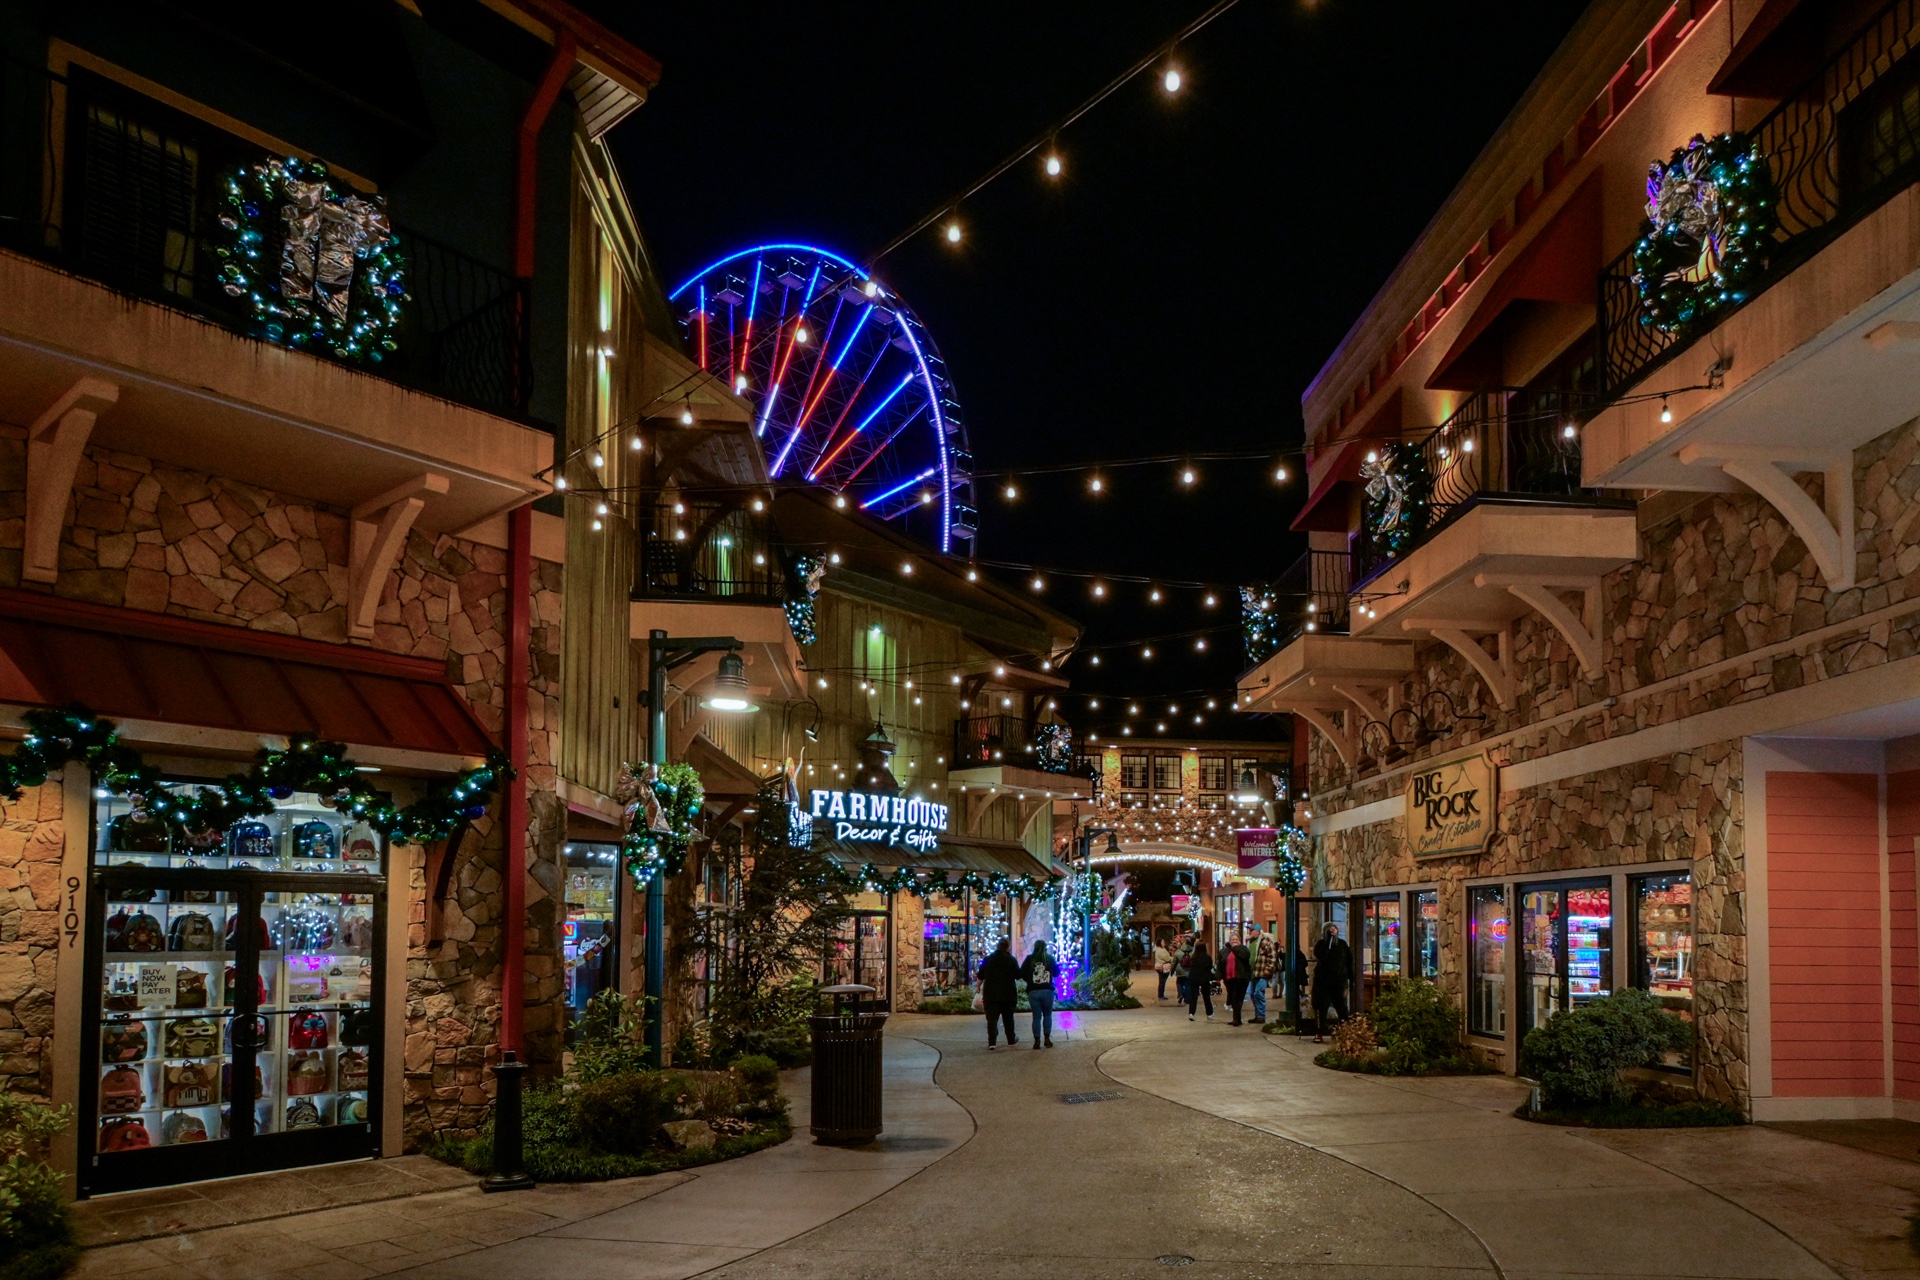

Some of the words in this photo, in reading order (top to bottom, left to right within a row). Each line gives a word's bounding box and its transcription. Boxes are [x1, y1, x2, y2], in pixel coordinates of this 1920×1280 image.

[811, 788, 948, 831] FARMHOUSE
[1413, 771, 1442, 808] BIG
[1424, 788, 1480, 832] ROCK
[836, 821, 887, 841] Decor
[889, 824, 901, 847] &
[905, 828, 938, 852] Gifts
[64, 876, 81, 948] 9107
[1504, 886, 1512, 926] 4105
[1491, 923, 1507, 935] OPE
